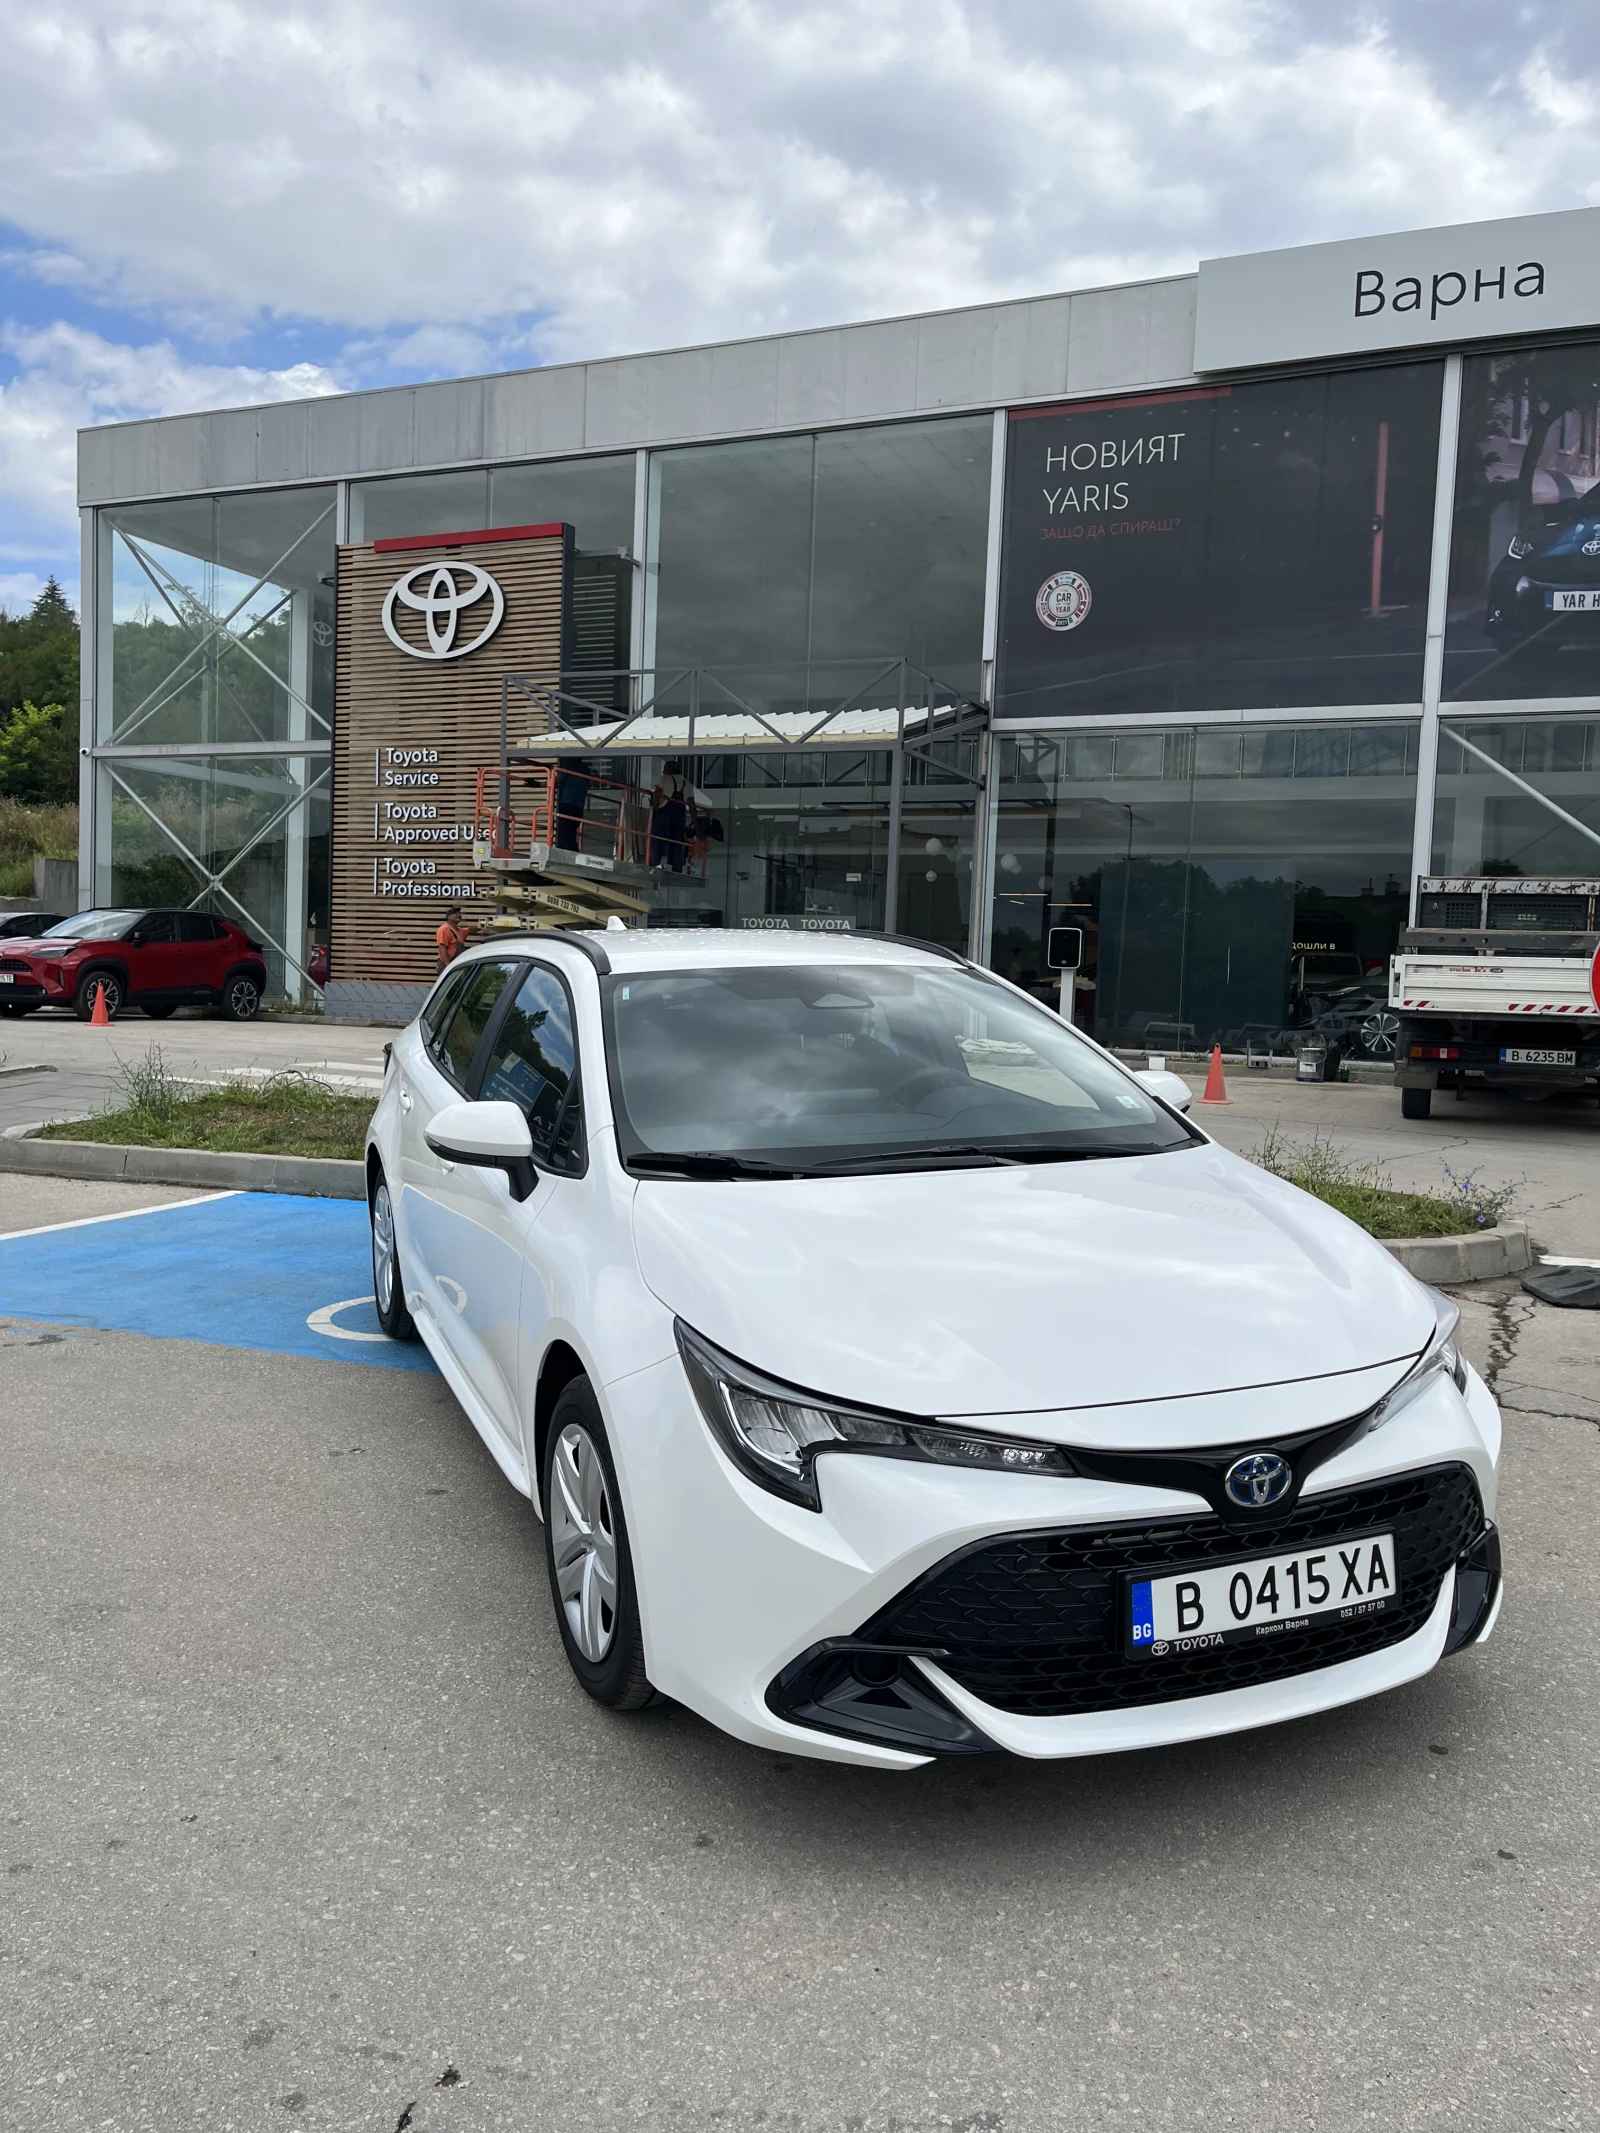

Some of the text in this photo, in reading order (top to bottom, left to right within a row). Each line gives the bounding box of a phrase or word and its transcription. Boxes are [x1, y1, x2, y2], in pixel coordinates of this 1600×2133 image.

[1354, 262, 1545, 321] Варна
[1046, 433, 1186, 473] НОВИЯТ
[1042, 481, 1129, 515] YARIS
[1040, 517, 1181, 541] ЗАЩО ДА СПИРАШ?
[1056, 592, 1072, 603] CAR
[1562, 594, 1586, 608] YAR
[385, 747, 438, 767] Toyota
[384, 769, 439, 786] Service
[384, 802, 437, 822] Toyota
[384, 824, 459, 844] Approved
[383, 857, 436, 878] Toyota
[382, 880, 476, 897] Professional
[741, 917, 790, 929] TOYOTA
[800, 918, 851, 930] TOYOTA
[1511, 1050, 1519, 1061] B
[1525, 1051, 1555, 1063] 6235
[1556, 1052, 1574, 1064] BM
[1175, 1543, 1390, 1634] B 0415 XA
[1340, 1607, 1354, 1618] 052
[1358, 1604, 1367, 1614] 57
[1367, 1602, 1376, 1612] 57
[1376, 1600, 1386, 1610] 00
[1132, 1623, 1152, 1640] BG
[1255, 1618, 1309, 1636] Карком Варна
[1173, 1633, 1225, 1653] TOYOTA
